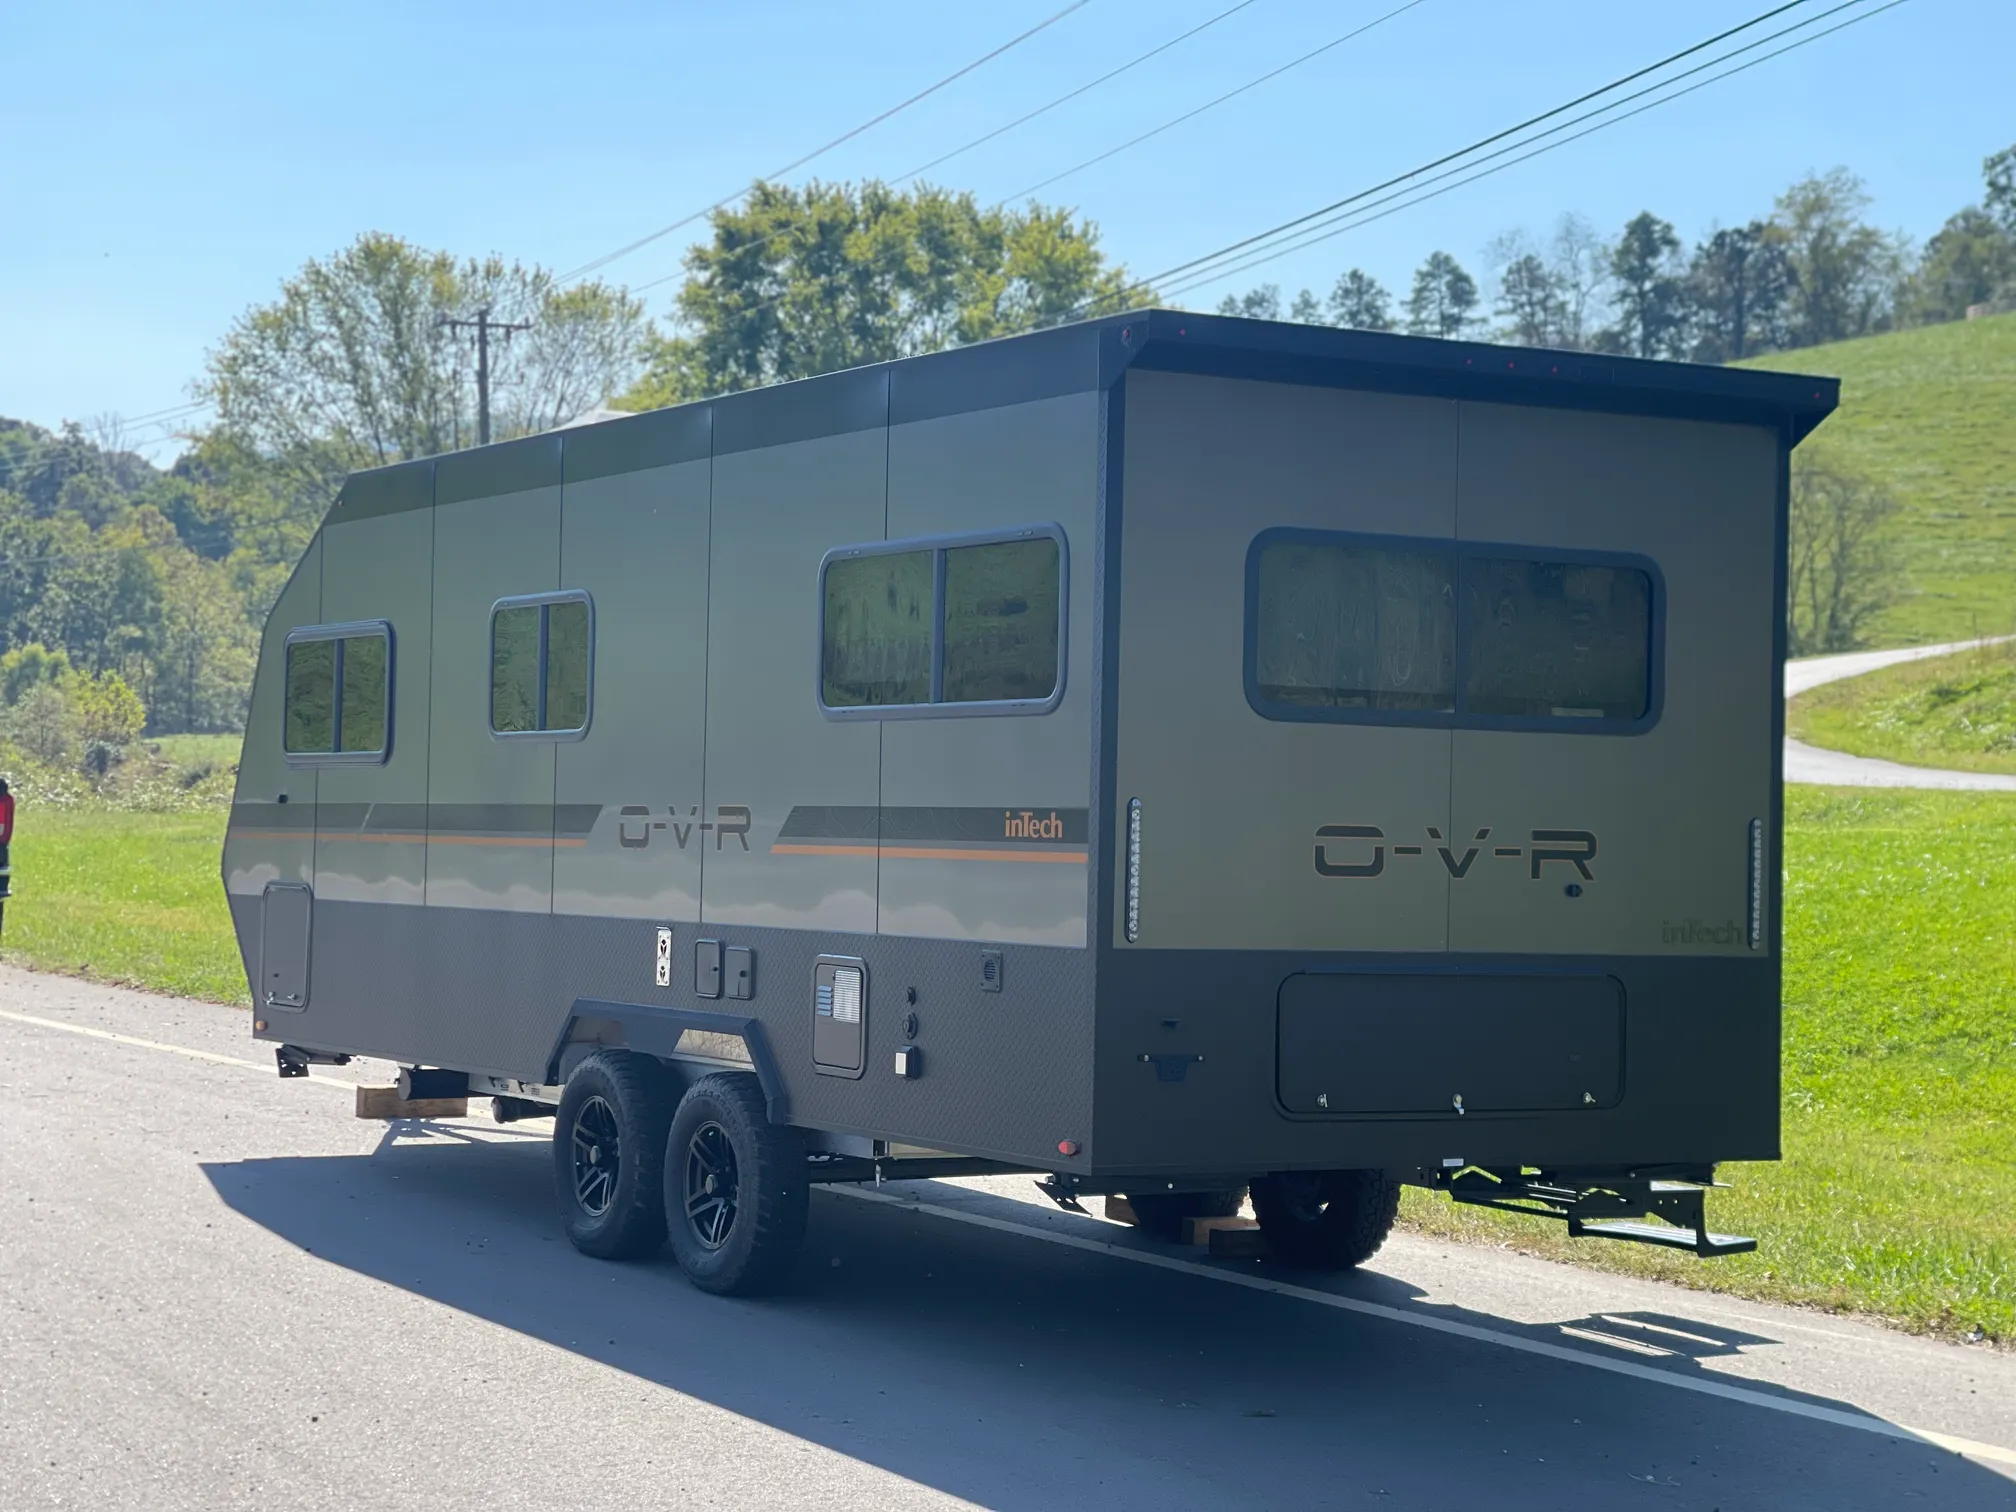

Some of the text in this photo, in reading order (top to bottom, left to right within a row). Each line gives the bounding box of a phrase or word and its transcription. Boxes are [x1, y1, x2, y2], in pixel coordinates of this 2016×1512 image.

[619, 804, 752, 852] O-V-R
[1004, 810, 1063, 839] inTech
[1313, 824, 1598, 881] O-V-R
